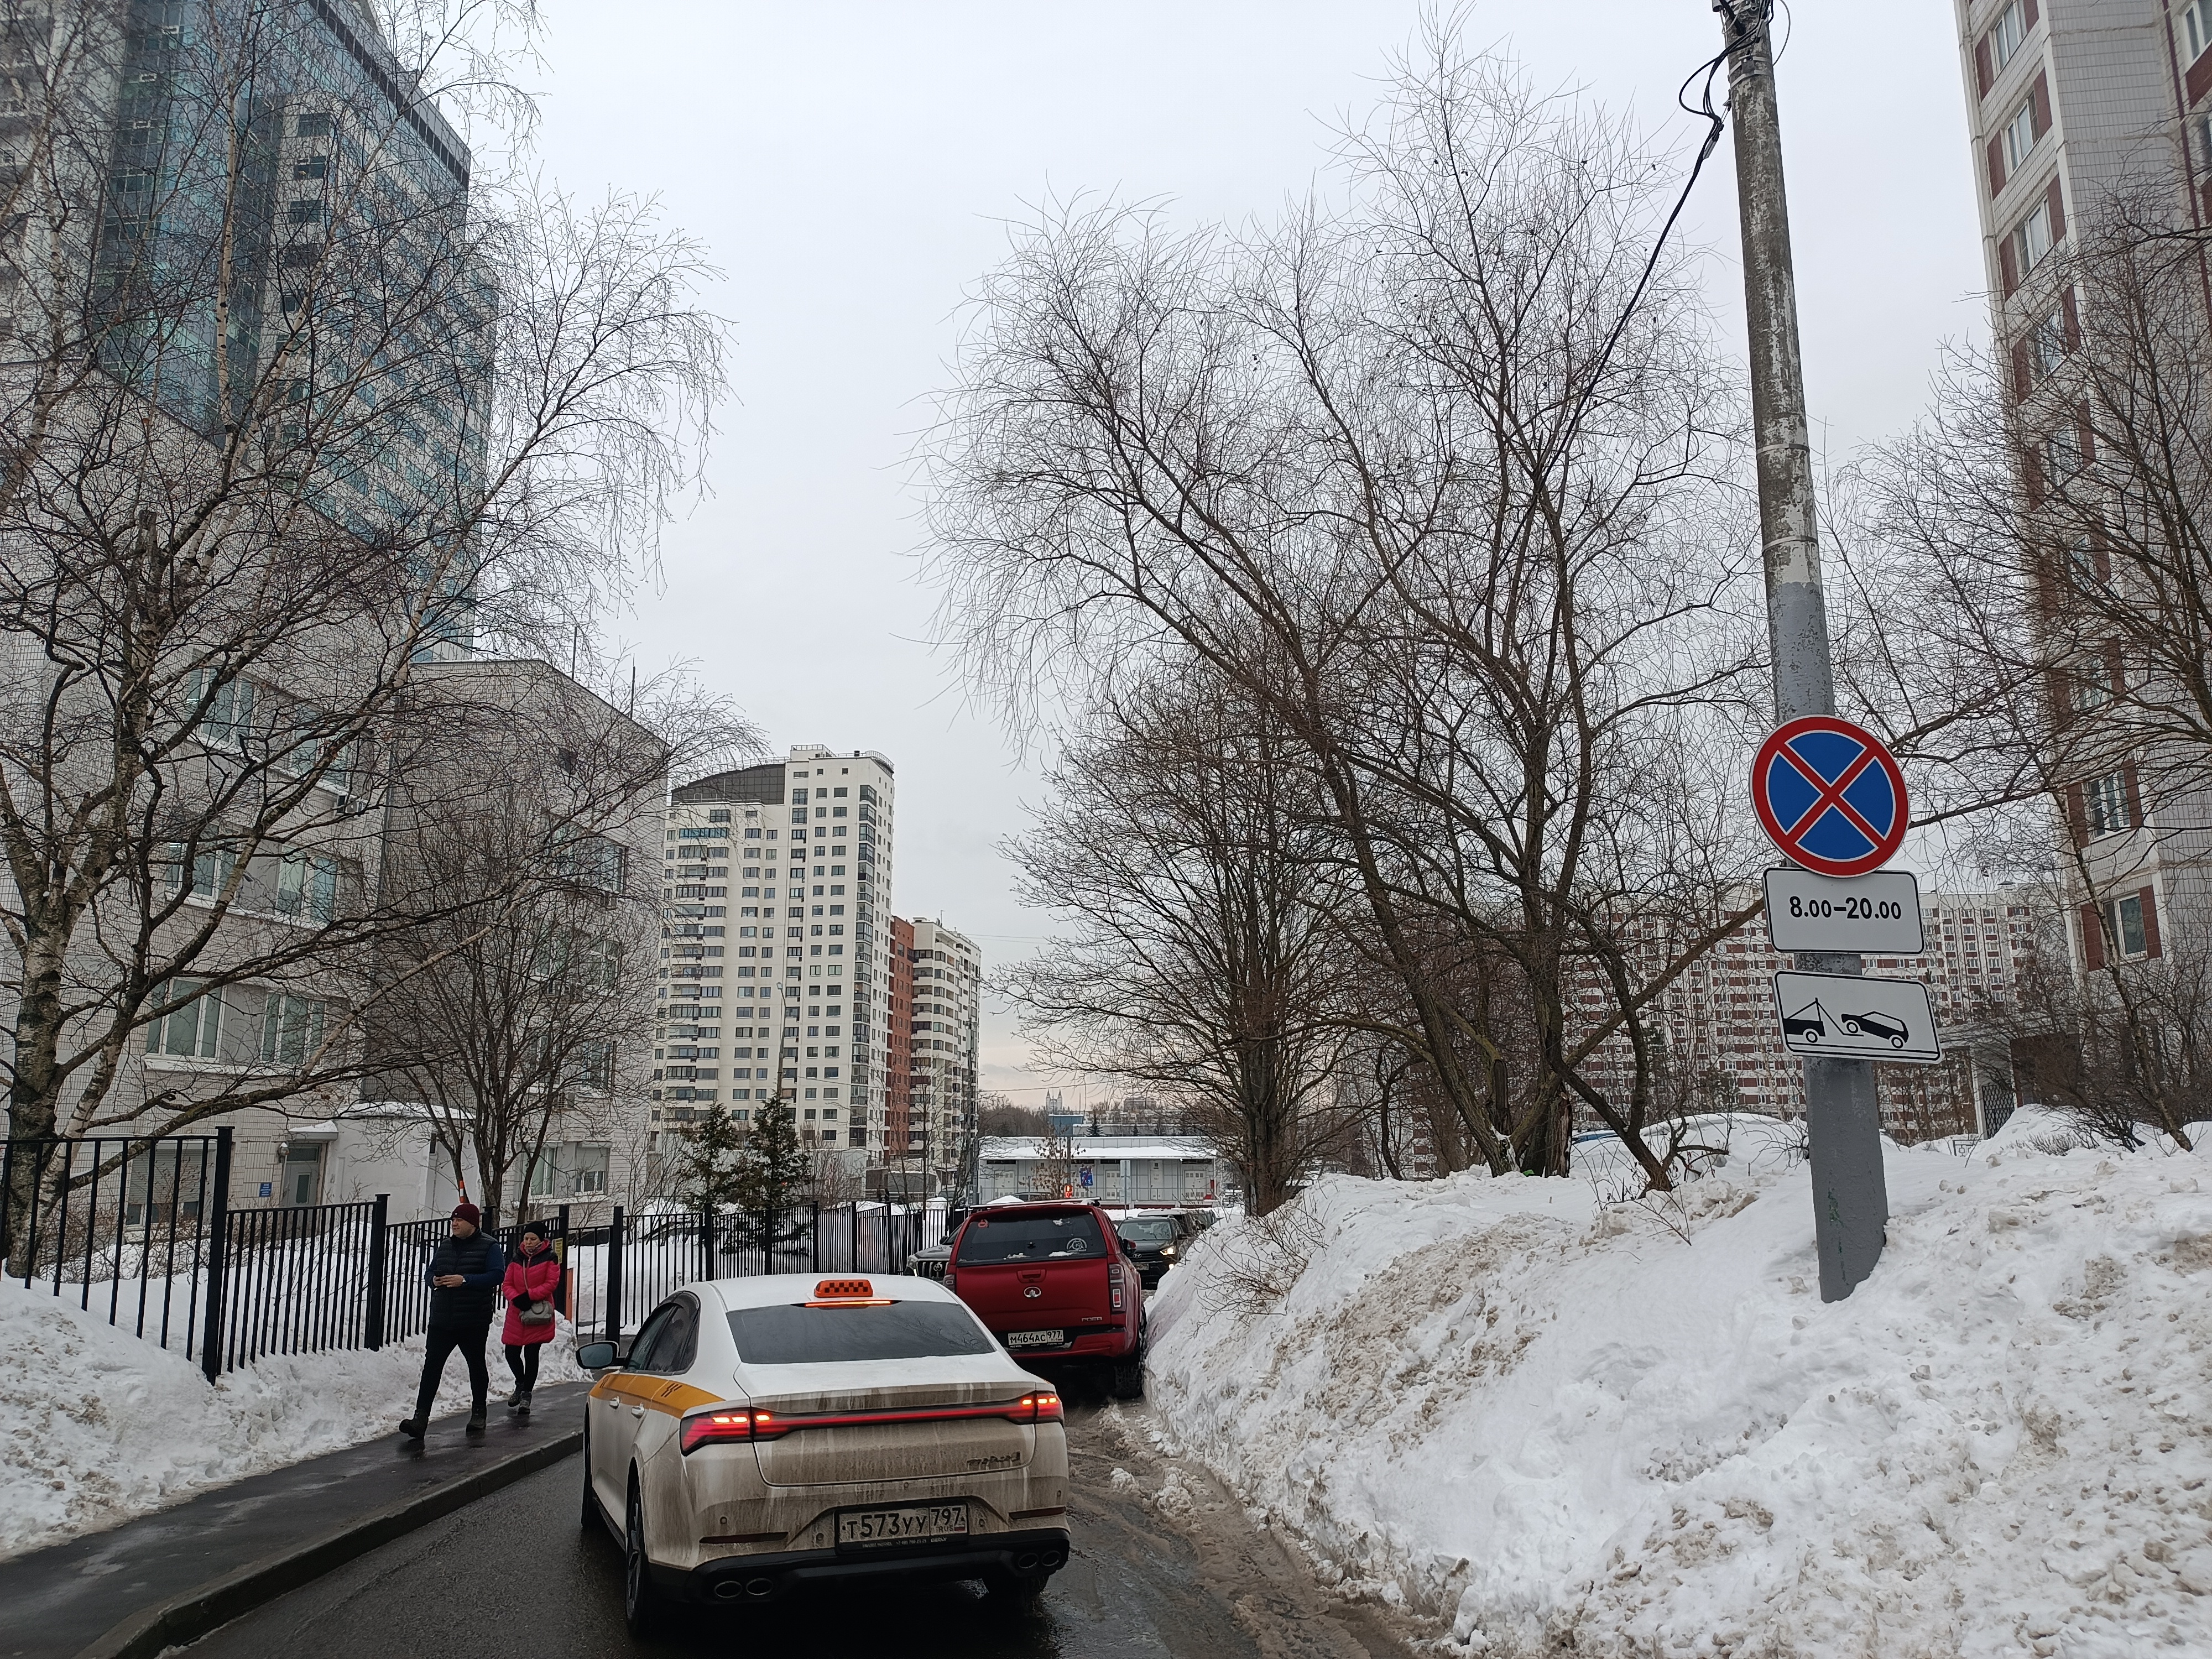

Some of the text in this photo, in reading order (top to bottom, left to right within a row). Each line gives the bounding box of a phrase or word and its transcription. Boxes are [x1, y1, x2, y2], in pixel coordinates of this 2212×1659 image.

[1010, 1333, 1046, 1344] М464АС
[846, 1507, 962, 1539] Т573УУ 797
